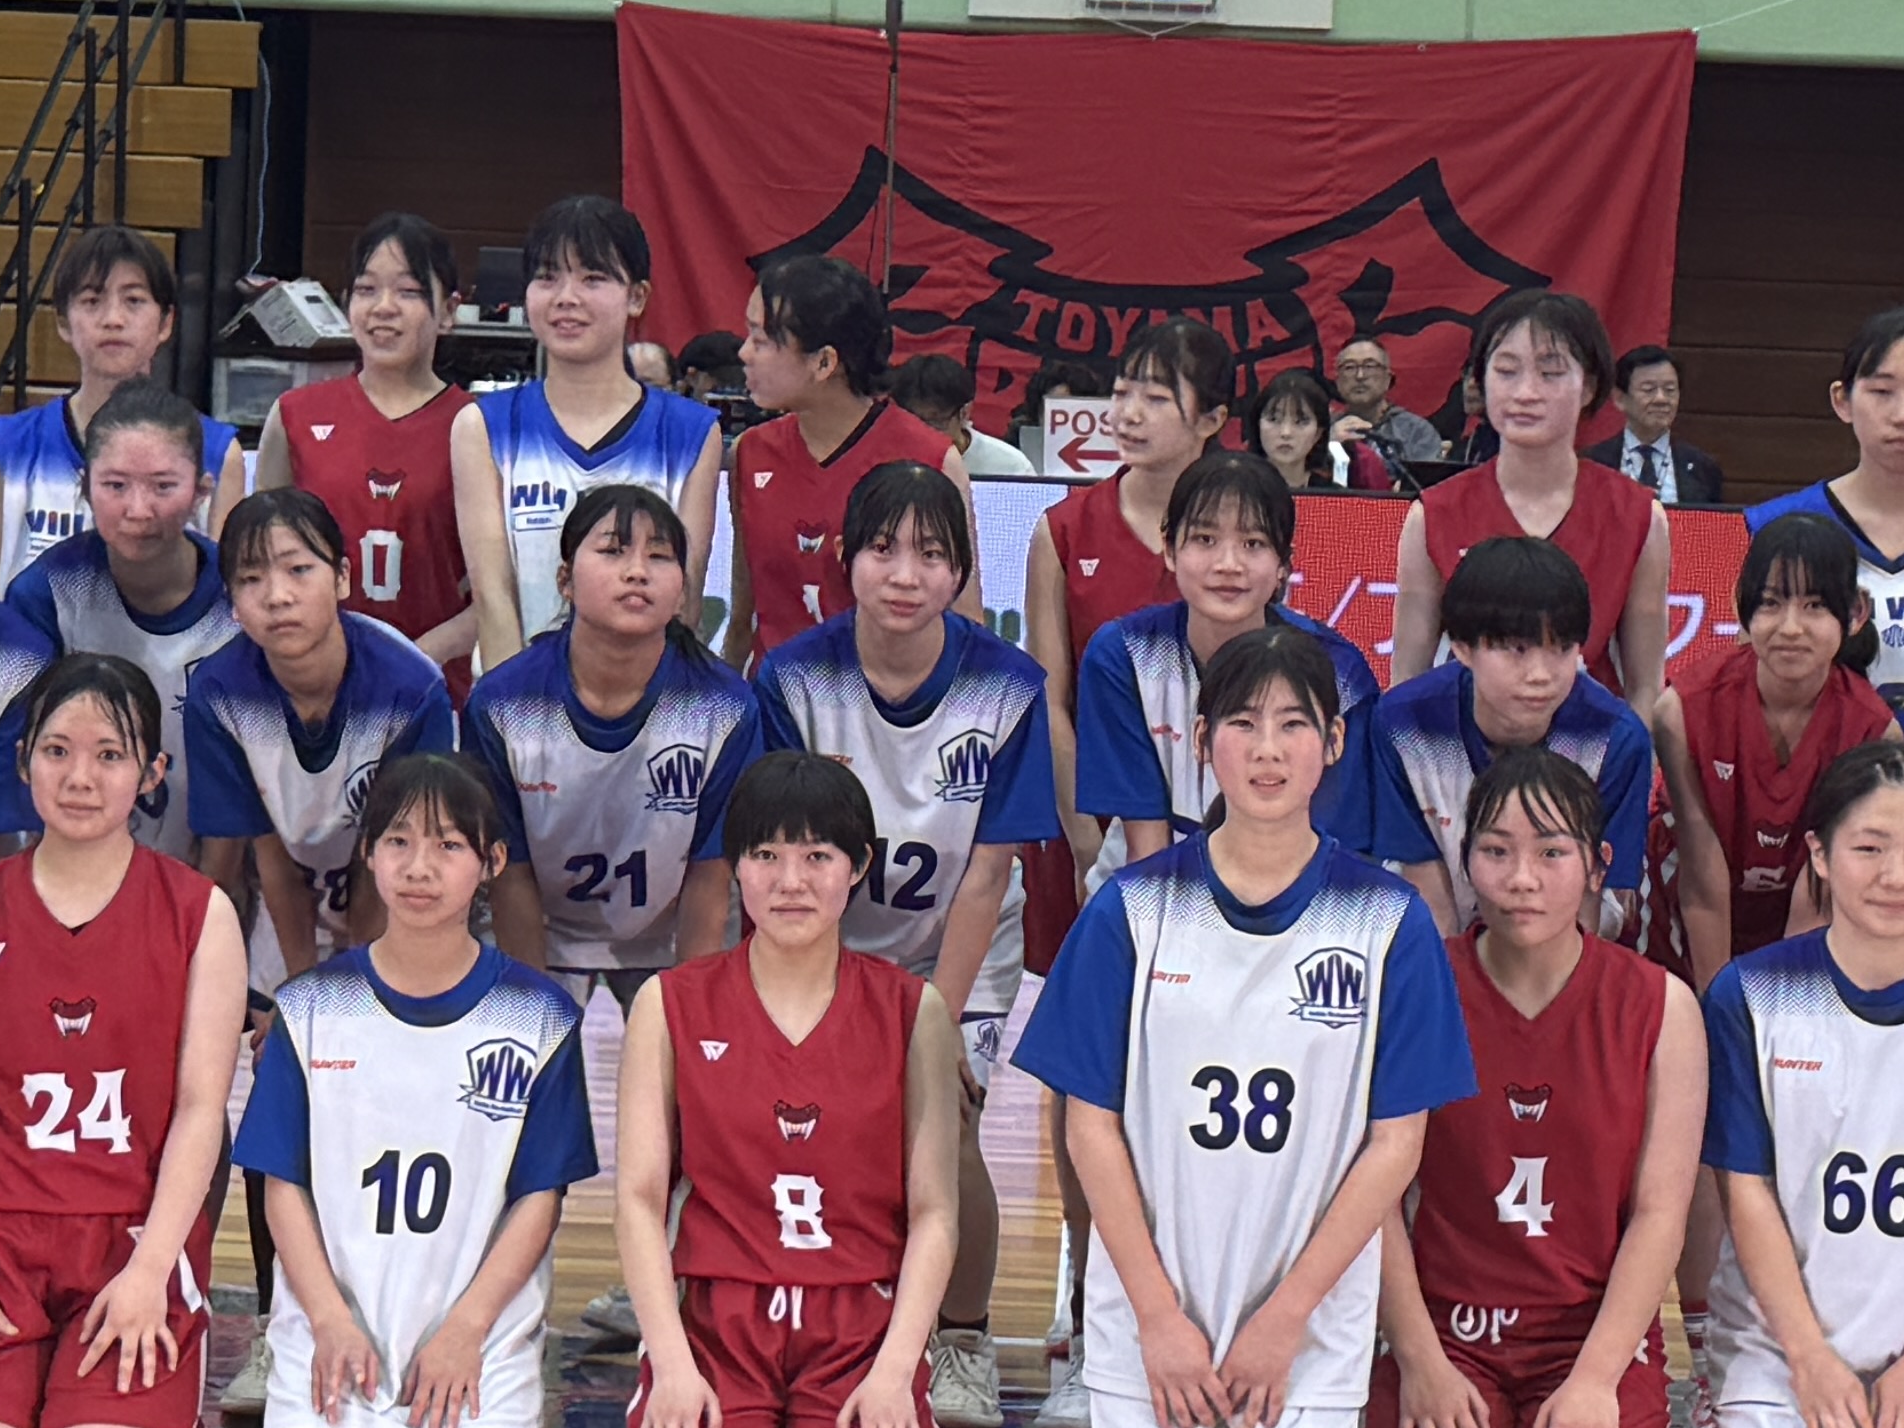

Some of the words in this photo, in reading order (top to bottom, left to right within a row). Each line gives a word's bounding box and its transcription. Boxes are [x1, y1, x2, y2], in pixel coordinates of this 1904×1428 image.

[1013, 288, 1290, 358] TOYMA
[359, 529, 403, 602] 0
[563, 850, 648, 908] 21
[868, 836, 938, 912] 12
[20, 1067, 133, 1155] 24
[1188, 1065, 1296, 1154] 38
[361, 1149, 452, 1235] 10
[769, 1174, 833, 1251] 8
[1495, 1156, 1555, 1238] 4
